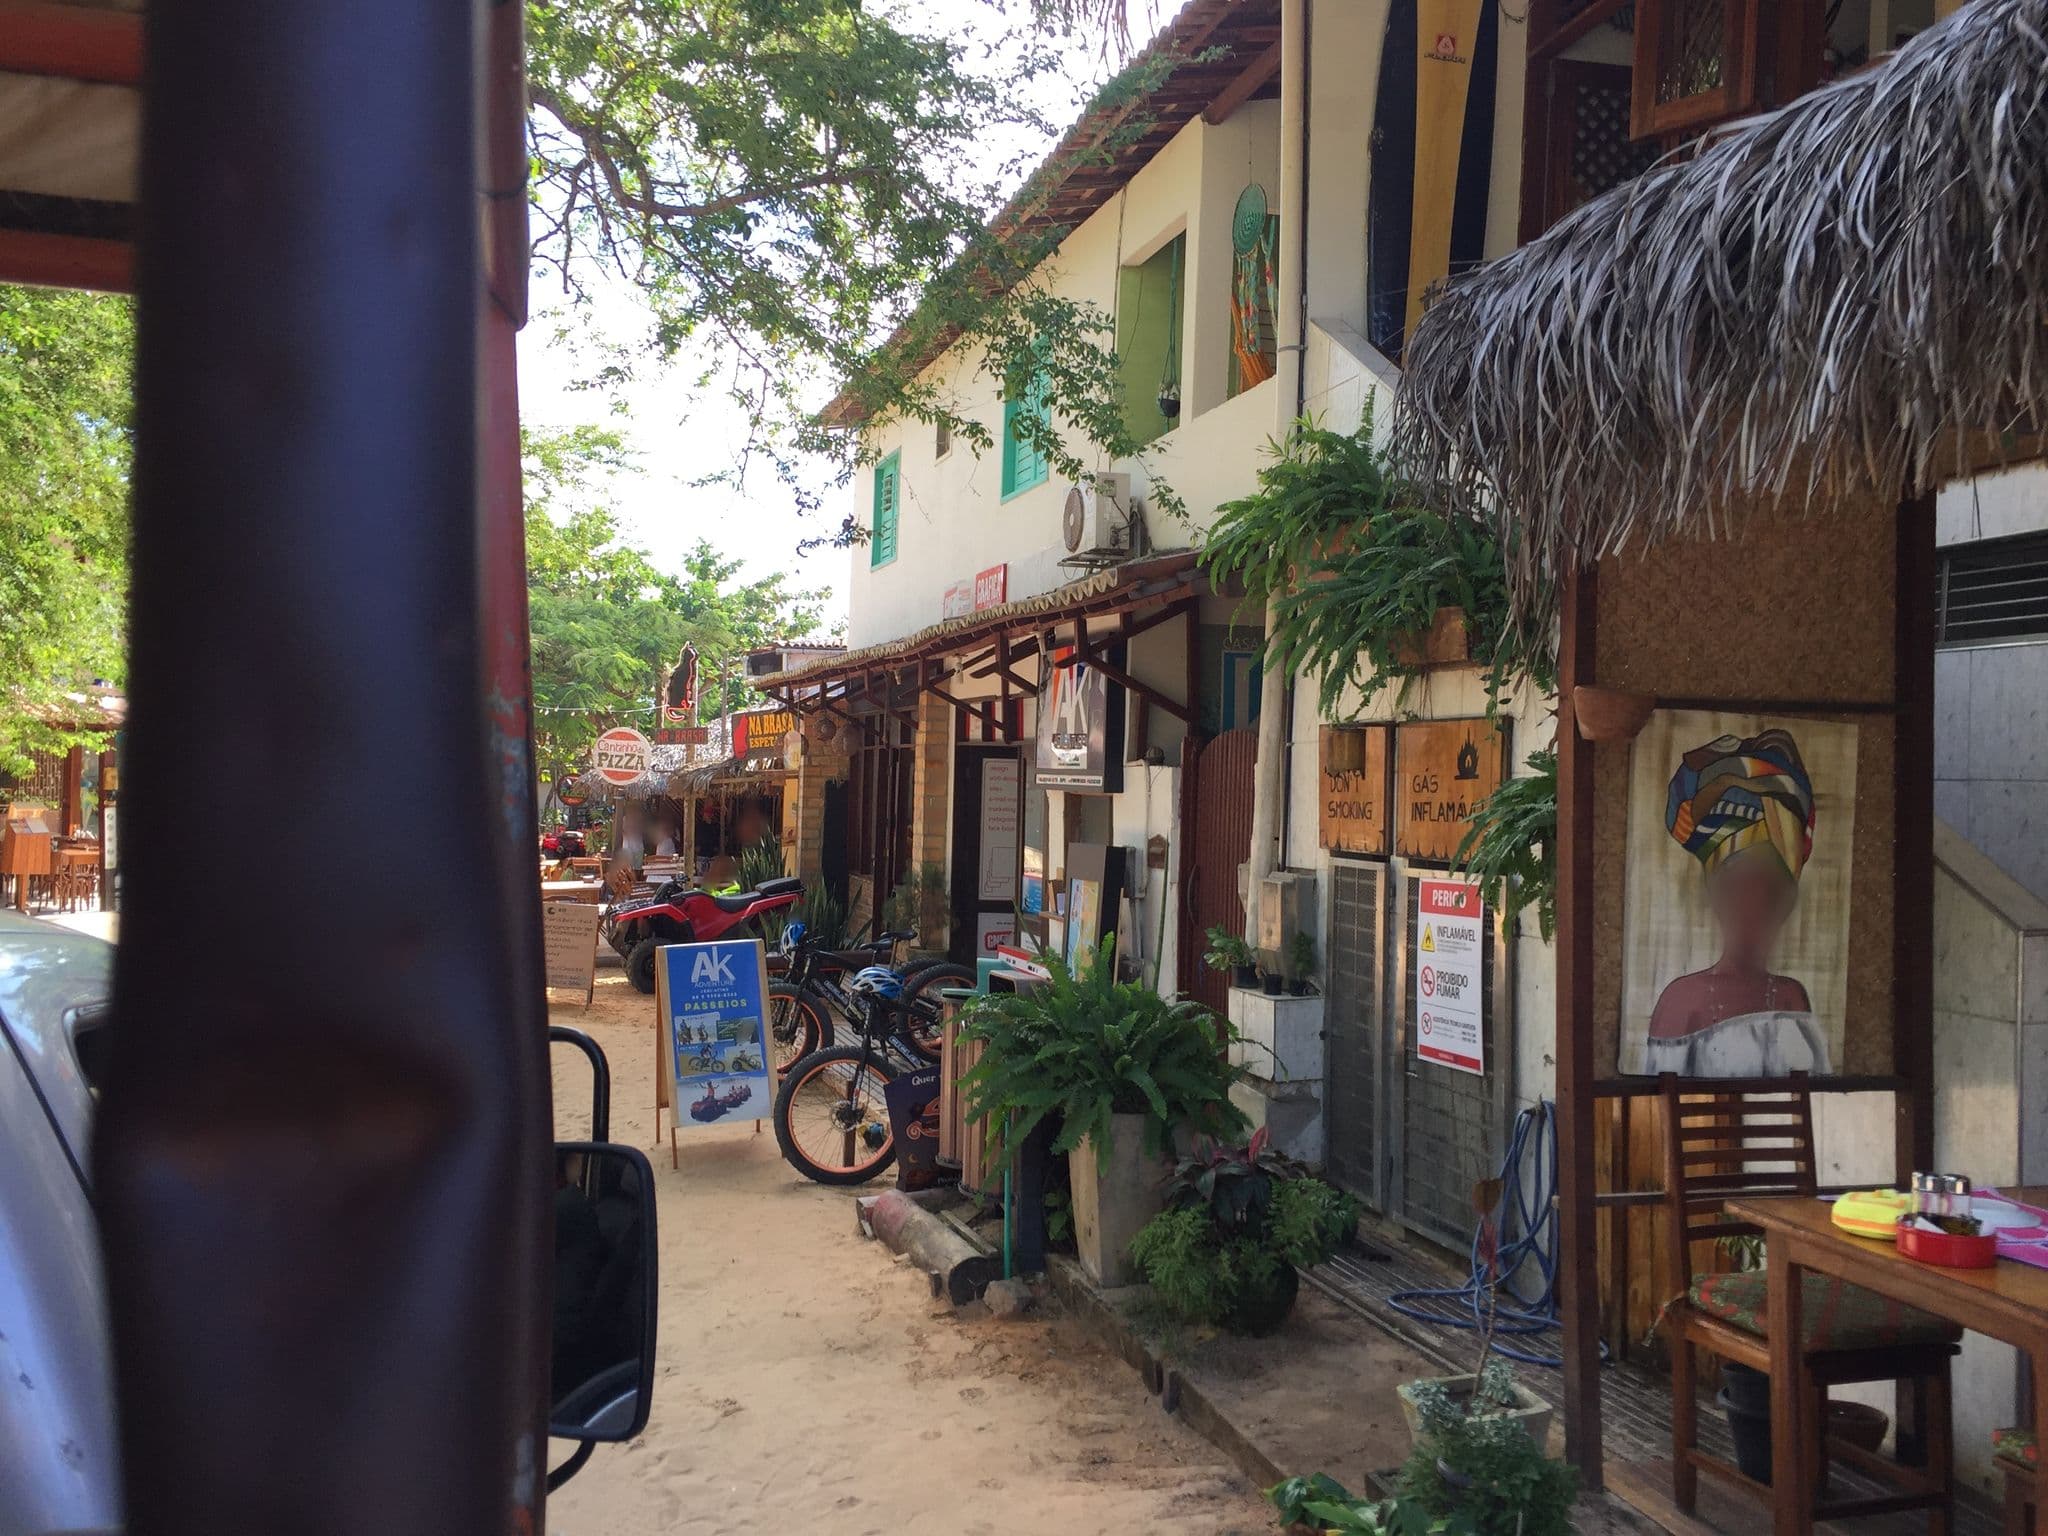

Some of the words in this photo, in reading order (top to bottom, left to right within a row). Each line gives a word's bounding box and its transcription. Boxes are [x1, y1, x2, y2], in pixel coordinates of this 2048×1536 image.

[749, 715, 762, 736] NA
[763, 711, 795, 735] BRASA
[597, 751, 646, 771] PIZZA
[1329, 773, 1361, 793] DON'T
[1412, 767, 1439, 794] GÁS
[1327, 801, 1374, 820] SMOKING
[1437, 925, 1476, 943] INFLAMÁVEL
[691, 945, 736, 983] AK
[1436, 970, 1469, 988] PROIBIDO
[1436, 983, 1461, 1000] FUMAR
[684, 998, 748, 1012] PASSEIOS
